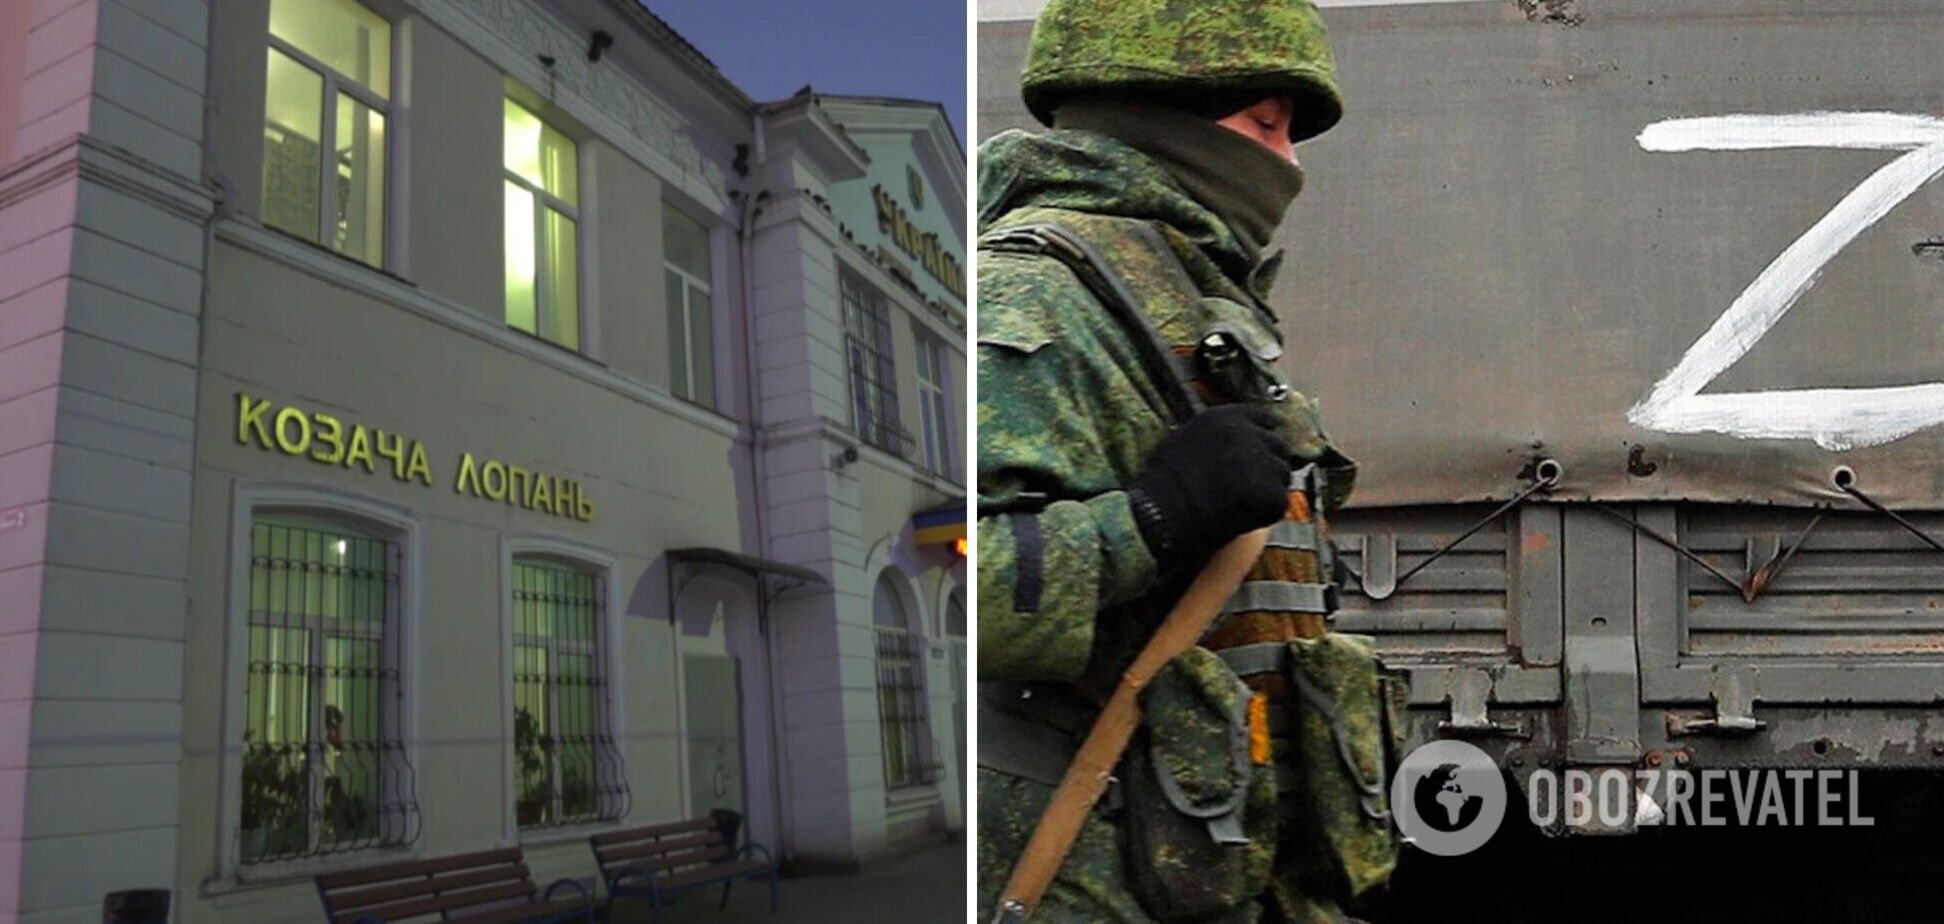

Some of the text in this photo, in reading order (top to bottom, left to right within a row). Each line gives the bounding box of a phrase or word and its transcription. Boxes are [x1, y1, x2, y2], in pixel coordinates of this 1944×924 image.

[1625, 110, 1944, 450] Z
[236, 393, 597, 522] КОЗАЧА ЛОПАНЬ
